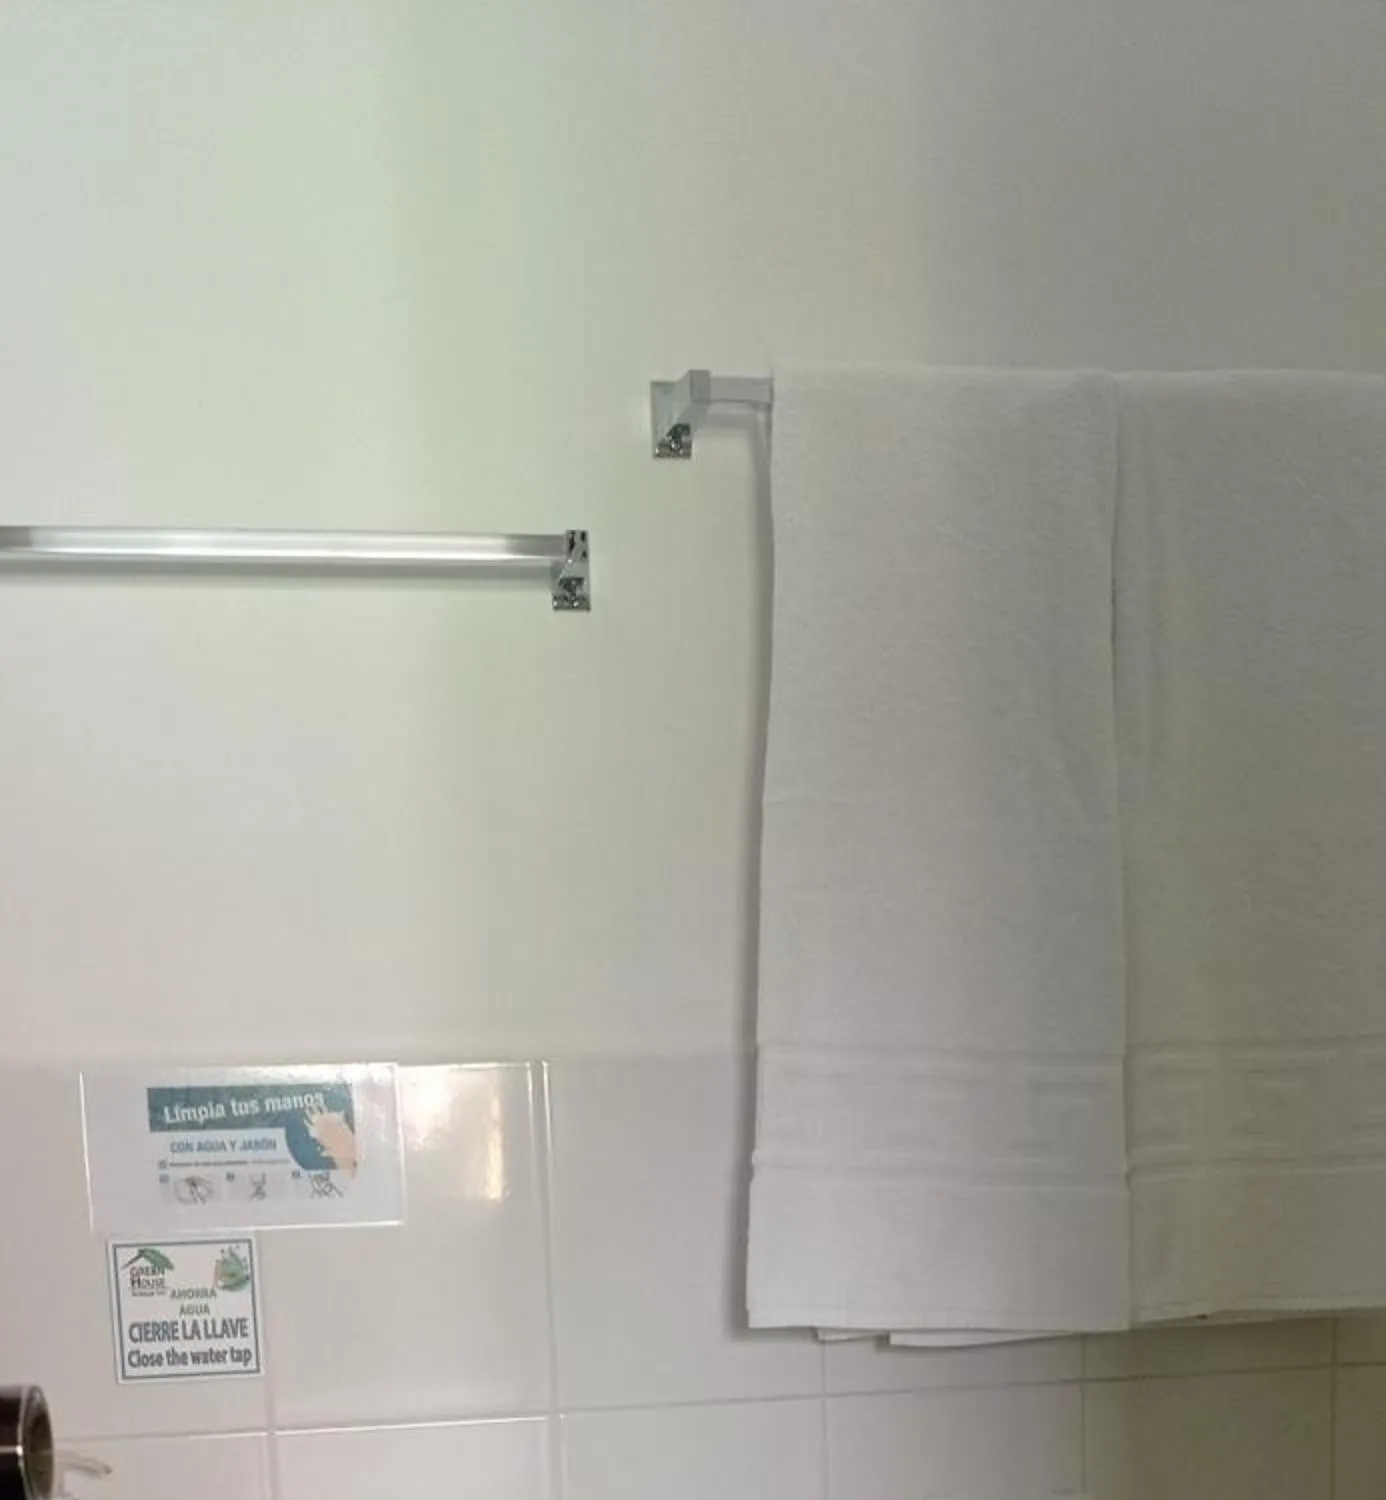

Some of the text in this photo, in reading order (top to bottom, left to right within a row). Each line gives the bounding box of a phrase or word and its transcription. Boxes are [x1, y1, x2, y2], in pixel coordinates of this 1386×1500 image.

[163, 1092, 325, 1125] Limpia tus manos
[169, 1139, 194, 1153] CON
[196, 1138, 226, 1152] AGUA
[227, 1138, 236, 1152] Y
[170, 1287, 217, 1300] AHORRA
[179, 1304, 211, 1317] AGUA
[128, 1317, 249, 1343] CIERRE LA LLAVE
[127, 1345, 253, 1369] Close the water tap
